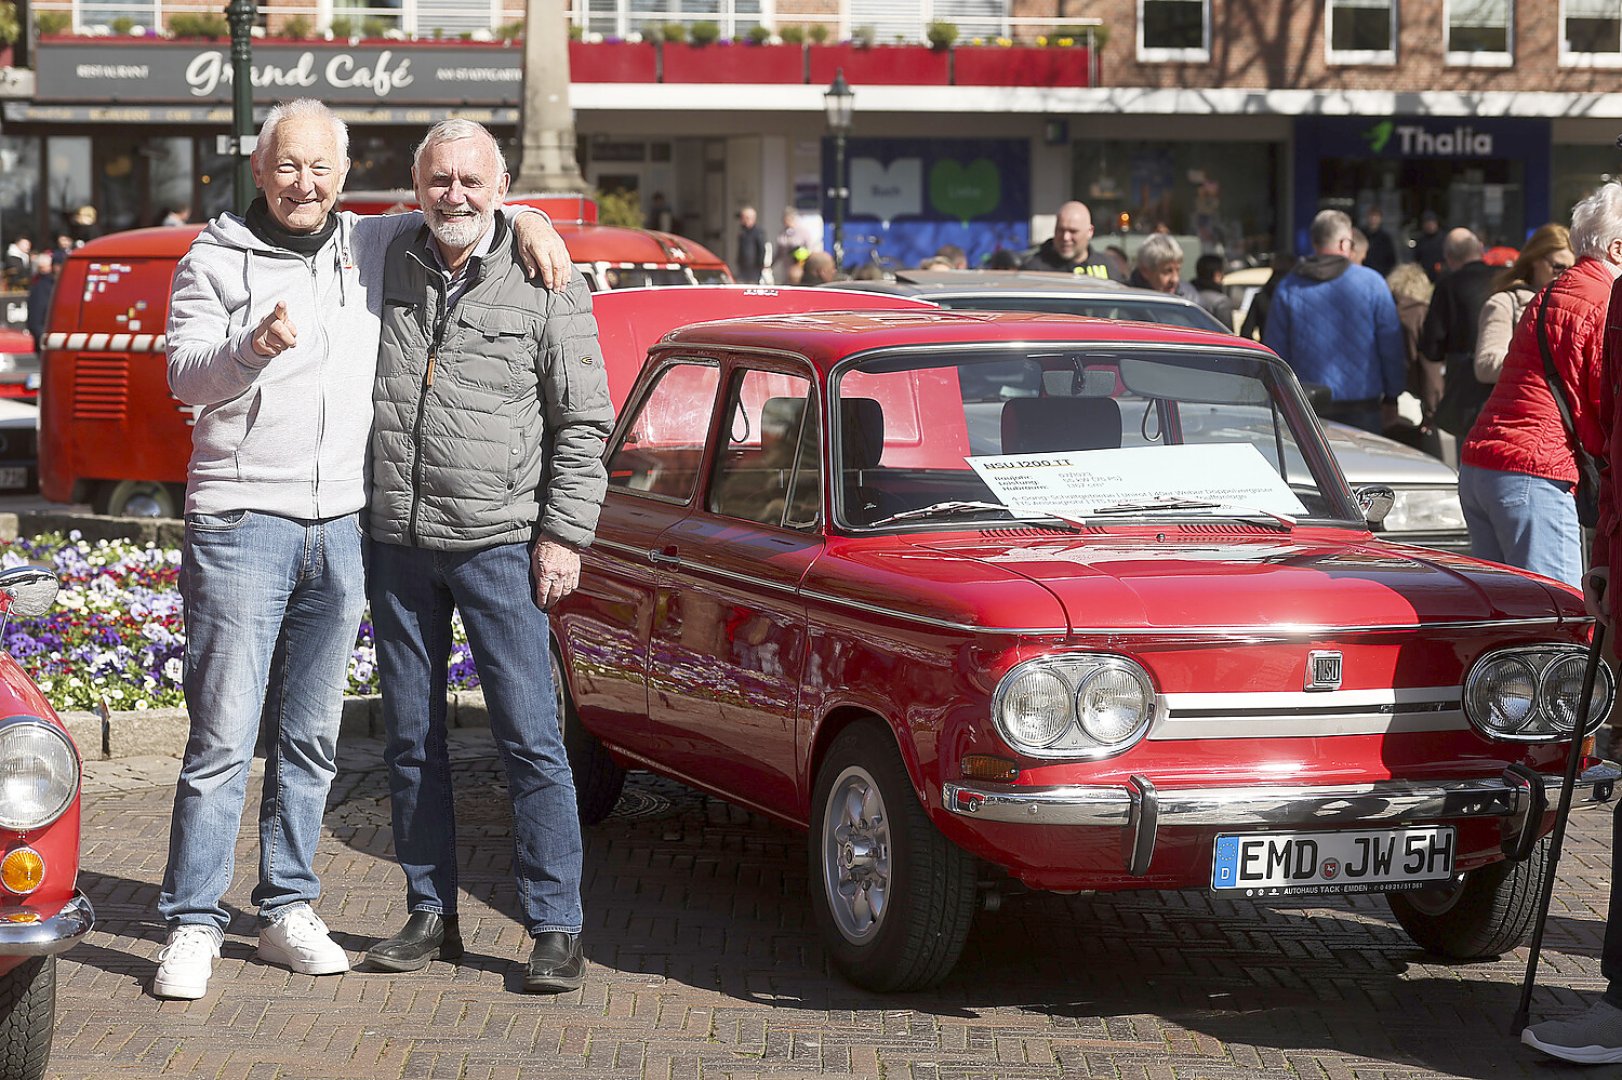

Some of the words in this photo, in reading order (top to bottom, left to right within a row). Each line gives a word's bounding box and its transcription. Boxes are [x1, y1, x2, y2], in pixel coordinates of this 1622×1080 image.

[325, 51, 414, 96] Café
[1396, 126, 1492, 154] Thalia
[1016, 460, 1051, 468] 1200
[1317, 659, 1339, 681] NSU
[1240, 839, 1318, 880] EMD
[1345, 836, 1396, 877] JW
[1403, 833, 1452, 874] 5H
[1221, 867, 1230, 880] D
[1284, 887, 1319, 895] AUTOHAUS
[1320, 885, 1341, 893] TACK
[1343, 884, 1368, 892] EMDEN
